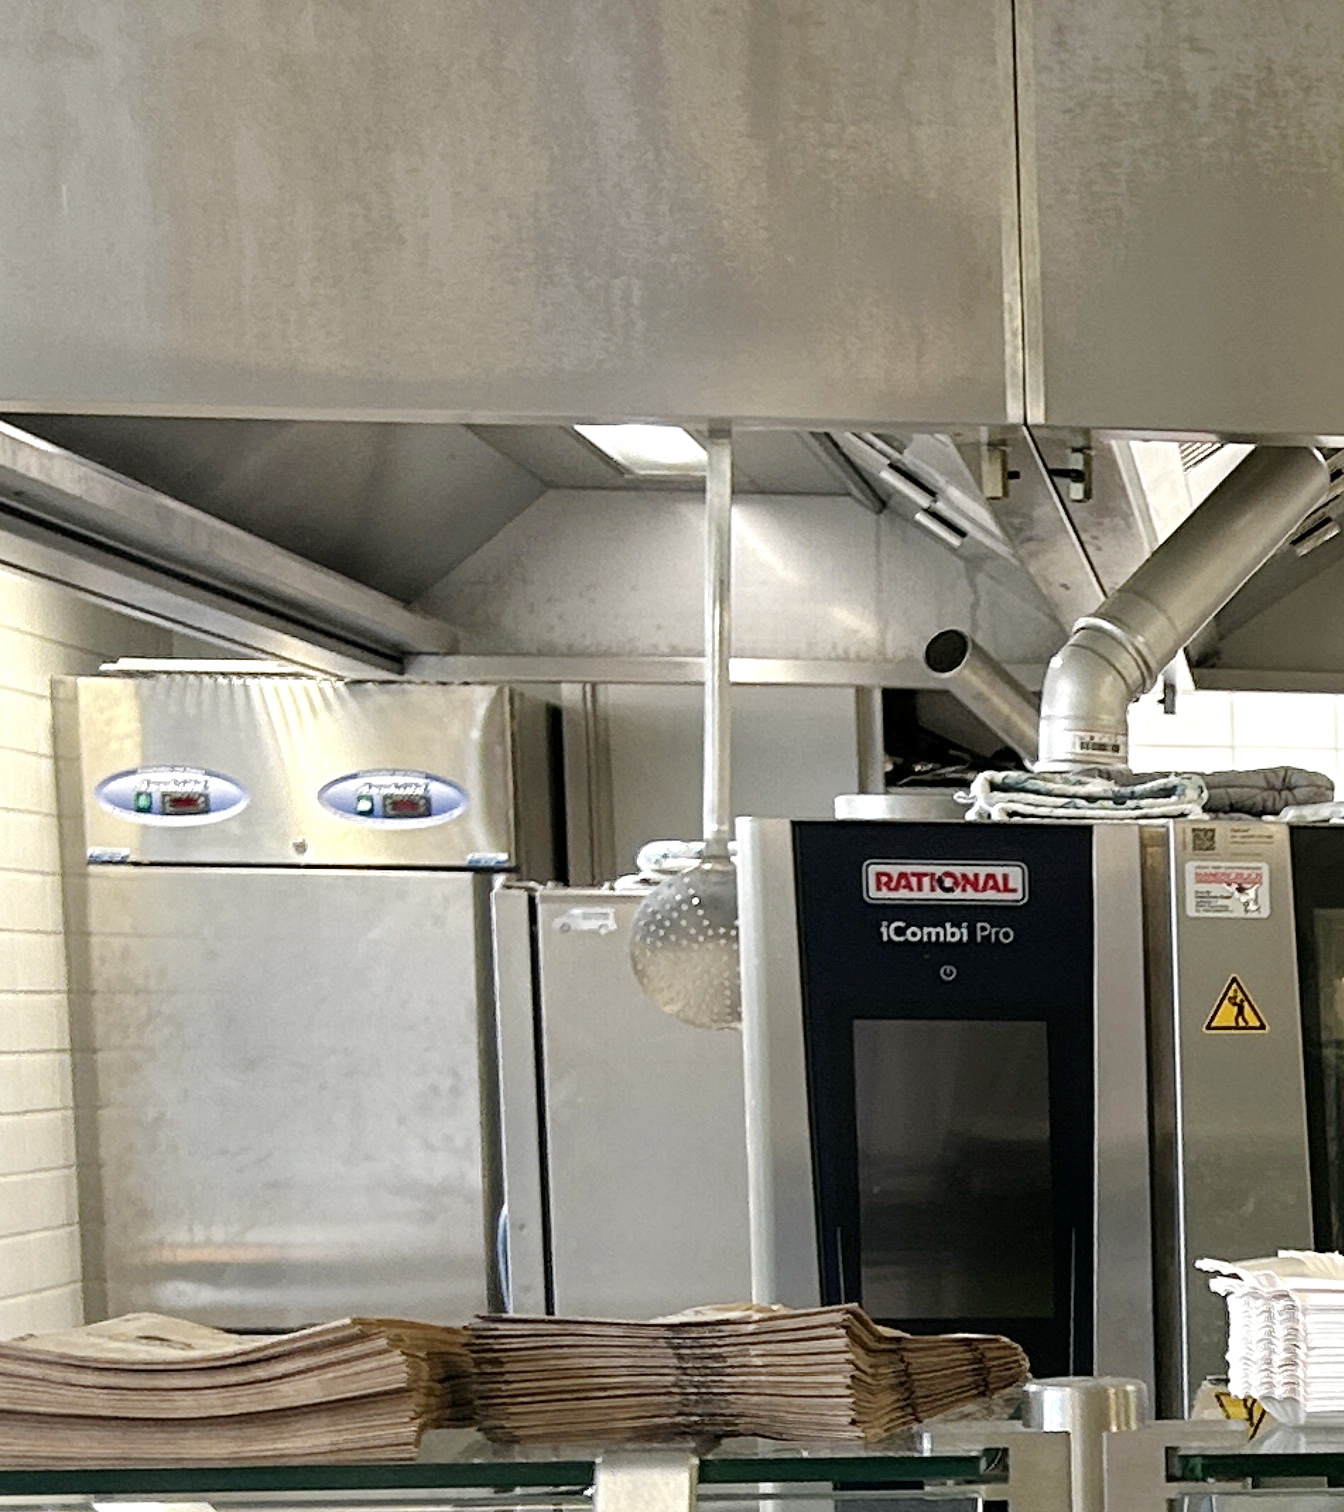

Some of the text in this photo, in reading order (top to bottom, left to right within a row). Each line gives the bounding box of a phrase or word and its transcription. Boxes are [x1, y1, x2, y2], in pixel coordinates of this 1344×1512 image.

[874, 870, 1018, 894] RATIONAL
[880, 920, 1015, 944] iCombi Pro
